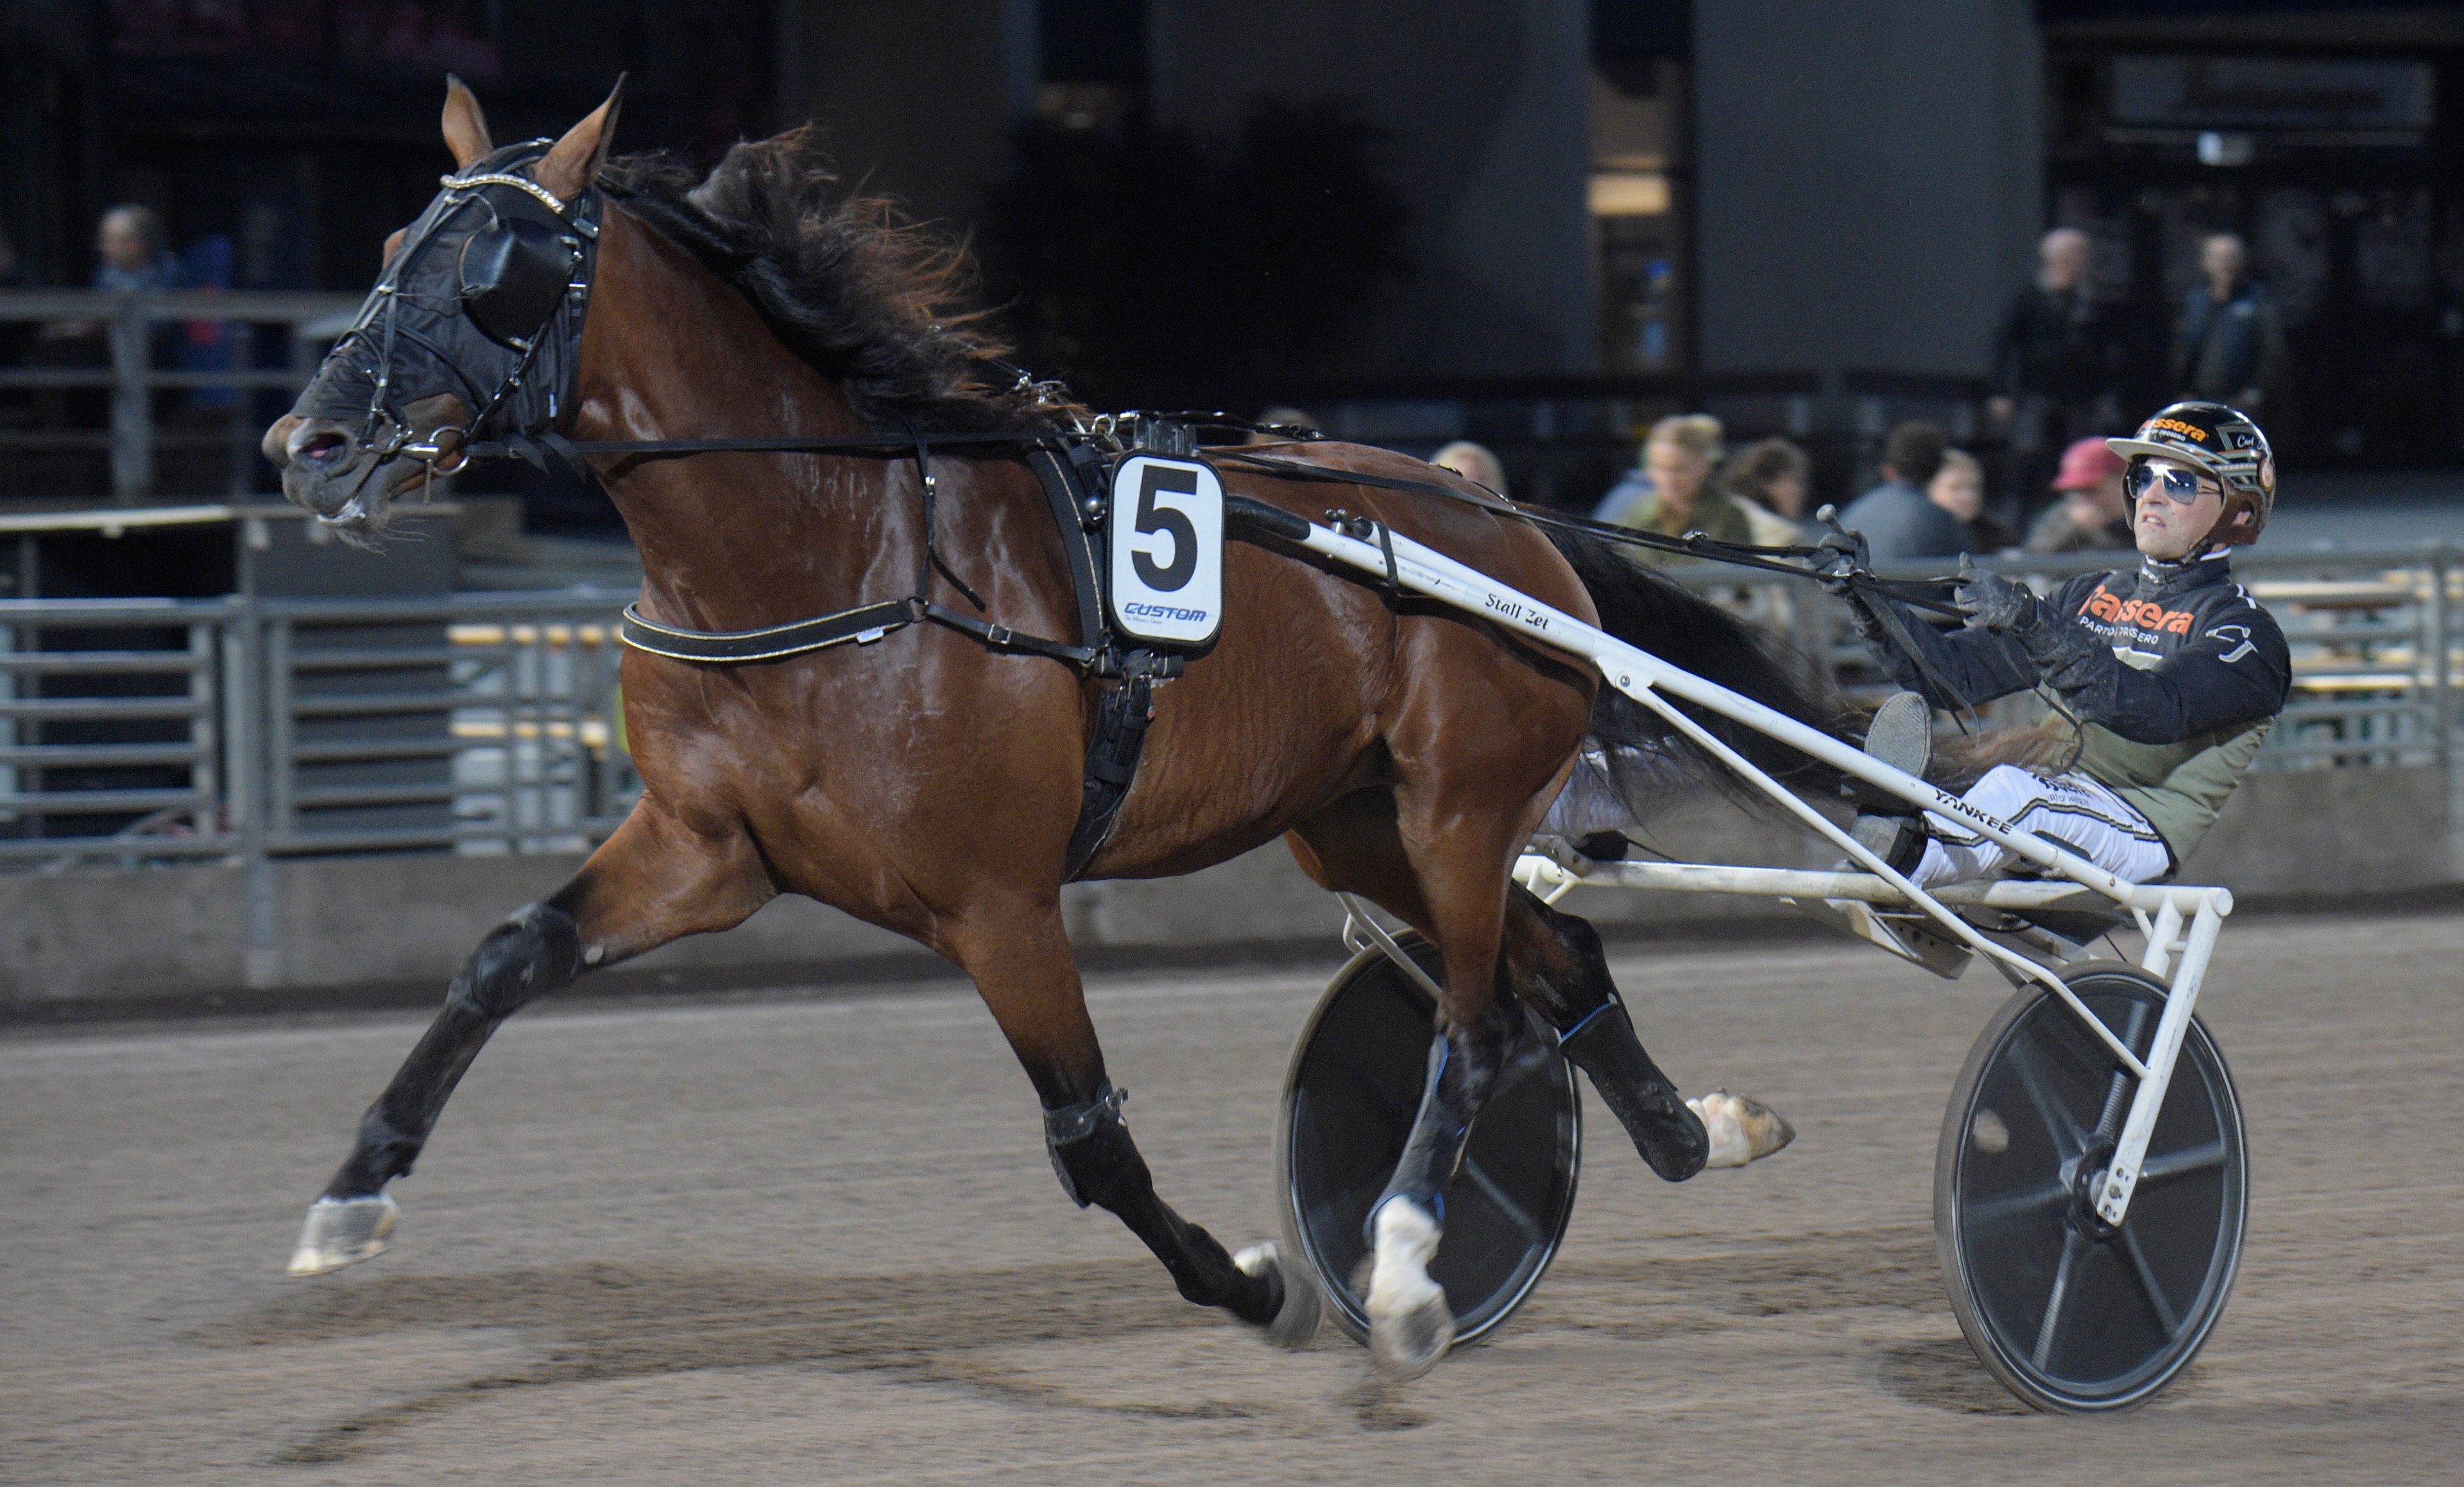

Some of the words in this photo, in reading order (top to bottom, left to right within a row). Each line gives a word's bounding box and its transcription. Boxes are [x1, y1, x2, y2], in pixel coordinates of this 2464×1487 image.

[2138, 418, 2207, 442] ssera
[1131, 464, 1198, 592] 5
[1124, 602, 1206, 622] CUSTOM
[1485, 593, 1521, 618] Stall
[1525, 609, 1550, 629] Zet
[1936, 789, 2012, 835] YANKEE
